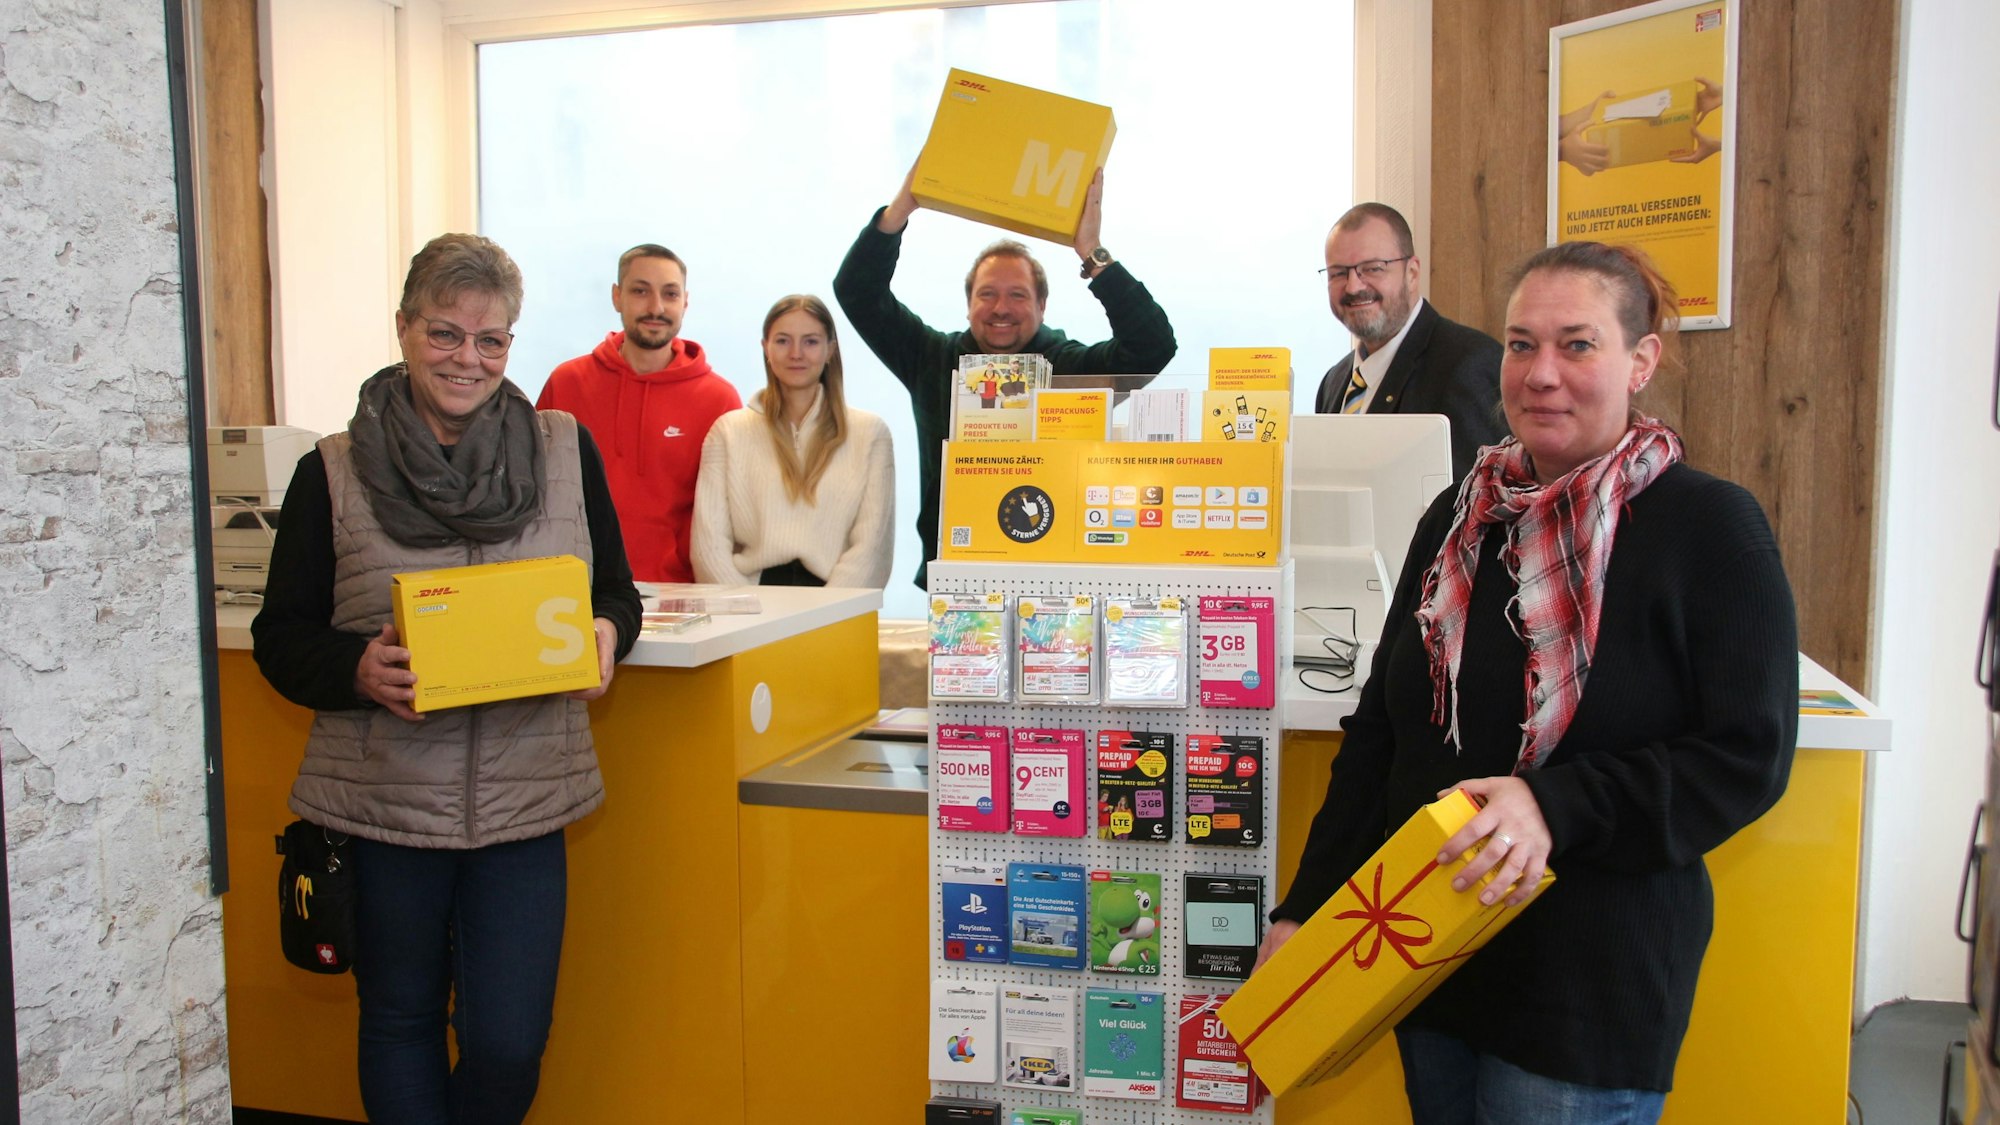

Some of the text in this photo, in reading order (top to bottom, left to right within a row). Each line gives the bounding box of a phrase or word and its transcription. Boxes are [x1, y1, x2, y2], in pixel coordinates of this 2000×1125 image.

[957, 80, 989, 92] DHL
[1012, 138, 1087, 208] M
[1567, 195, 1701, 221] KLIMANEUTRAL VERSENDEN
[1567, 224, 1586, 235] UND
[1588, 220, 1615, 232] JETZT
[1617, 216, 1642, 229] AUCH
[1646, 208, 1712, 226] EMPFANGEN:
[1016, 455, 1044, 464] ZÄHLT:
[1011, 495, 1050, 539] STERNE VERGEBEN
[416, 586, 455, 598] DHL
[1204, 600, 1214, 608] 10
[536, 596, 584, 665] S
[1202, 635, 1245, 660] 3 GB
[1017, 732, 1027, 740] 10
[1100, 752, 1131, 760] PREPAID
[1188, 757, 1222, 765] PREPAID
[941, 763, 990, 776] 500 MB
[1016, 766, 1064, 790] 9 CENT
[959, 924, 991, 933] PlayStation
[1099, 1019, 1146, 1029] Viel Glück
[1203, 1019, 1228, 1039] 50
[1197, 1040, 1236, 1049] MITARBEITER
[1197, 1048, 1236, 1056] GUTSCHEIN
[1024, 1058, 1052, 1069] IKEA
